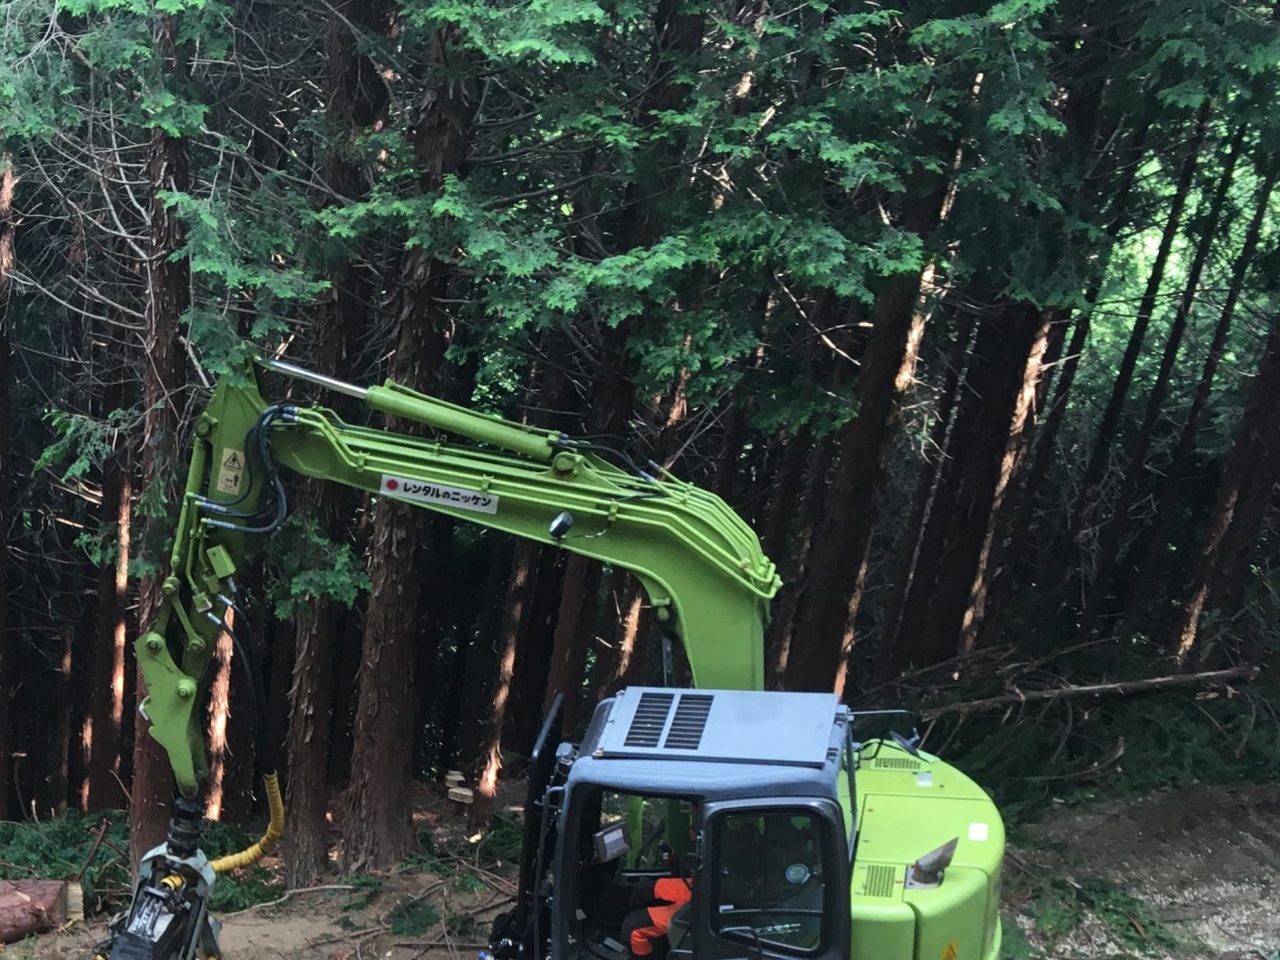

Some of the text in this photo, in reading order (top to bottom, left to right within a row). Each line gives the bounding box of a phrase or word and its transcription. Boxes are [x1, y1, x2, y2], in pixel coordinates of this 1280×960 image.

[403, 482, 492, 507] レンタルのニッケン
